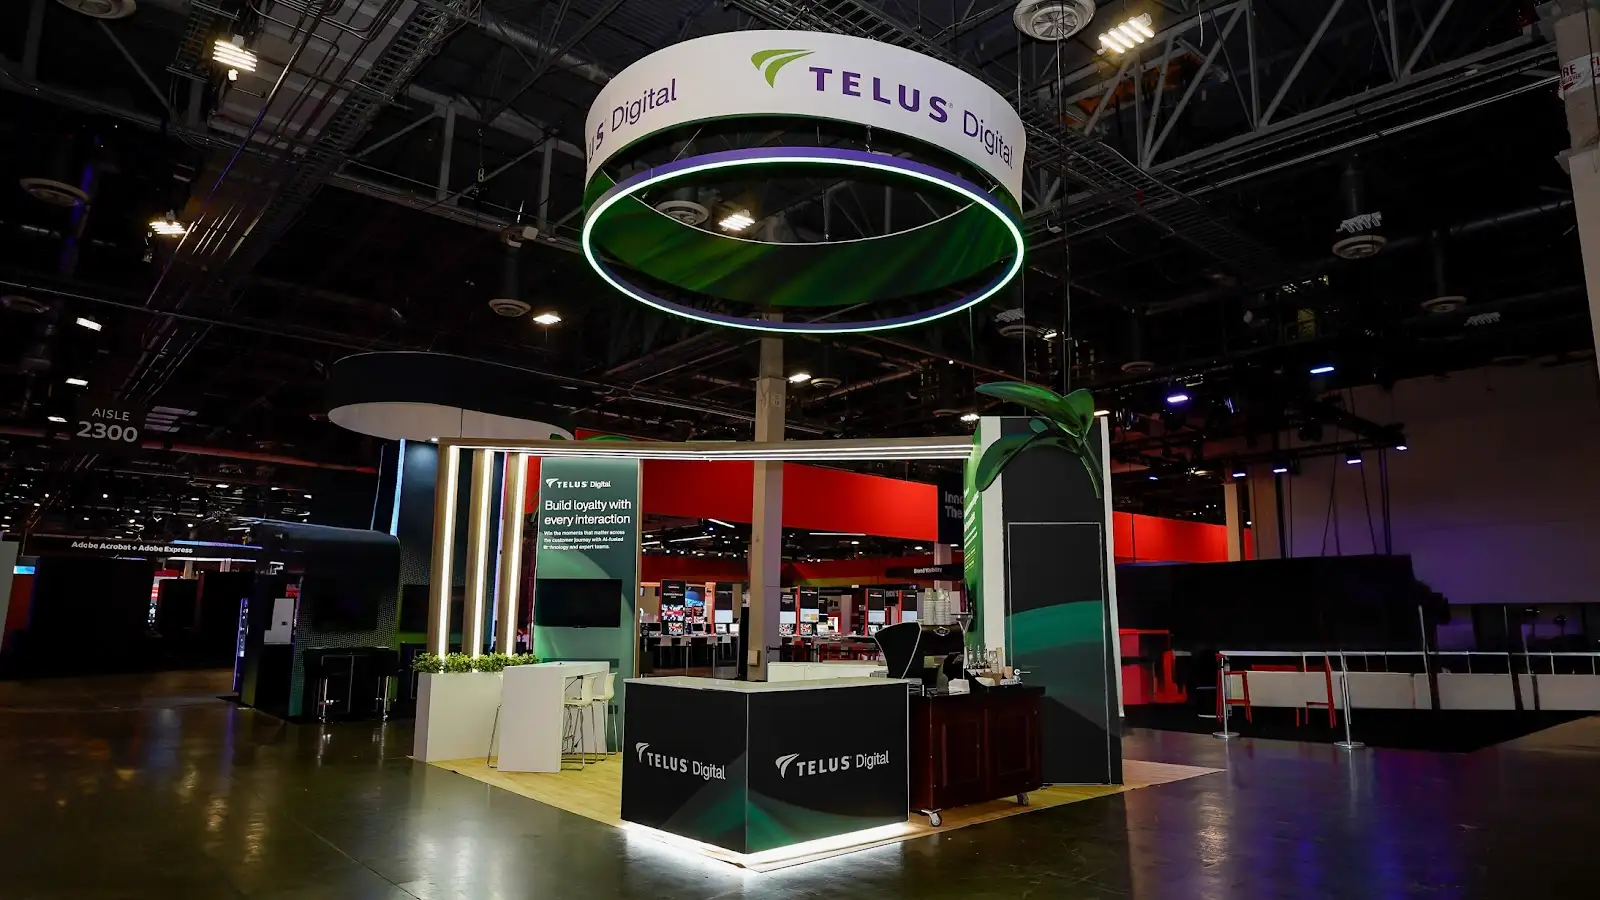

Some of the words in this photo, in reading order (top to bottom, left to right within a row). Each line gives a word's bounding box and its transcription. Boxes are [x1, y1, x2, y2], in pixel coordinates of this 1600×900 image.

[611, 78, 677, 132] Digital
[963, 109, 1013, 170] Digital
[91, 407, 130, 421] AISLE
[76, 420, 138, 443] 2300
[556, 481, 588, 489] TELUS
[589, 480, 612, 489] Digital
[544, 500, 572, 511] Build
[573, 499, 608, 512] loyalty
[608, 499, 632, 510] with
[544, 515, 574, 527] every
[575, 514, 631, 525] interaction
[71, 541, 98, 549] Adobe
[647, 752, 688, 773] TELUS
[692, 760, 726, 781] Digital
[796, 755, 851, 777] TELUS
[856, 750, 889, 770] Digital
